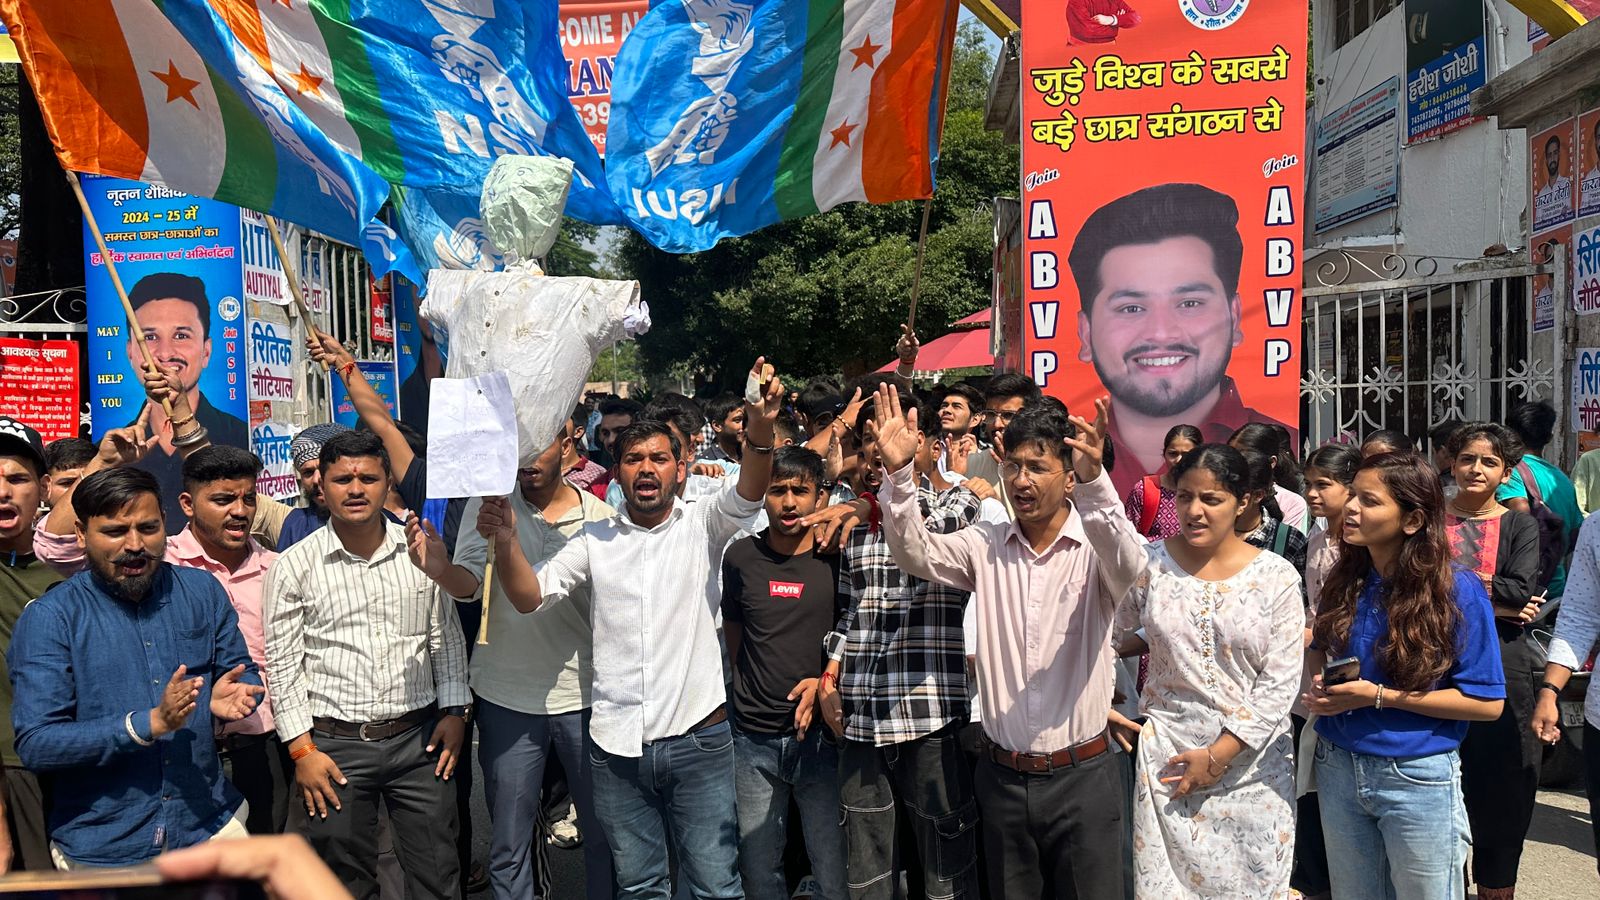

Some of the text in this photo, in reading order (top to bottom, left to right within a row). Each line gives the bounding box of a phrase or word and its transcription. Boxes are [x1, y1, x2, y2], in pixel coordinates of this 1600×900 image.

[559, 14, 615, 47] COME
[1094, 54, 1165, 91] विश्व
[1172, 50, 1205, 86] के
[1211, 45, 1290, 84] सबसे
[1408, 42, 1479, 102] हरीश जोशी
[1084, 114, 1141, 142] छात्र
[1147, 103, 1247, 138] संगठन
[1253, 96, 1284, 133] से
[1263, 153, 1298, 178] Join
[1025, 167, 1060, 191] Join
[106, 187, 142, 207] नूतन
[122, 211, 149, 224] 2024
[167, 210, 180, 222] 25
[184, 205, 199, 221] में
[104, 231, 136, 243] समस्त
[203, 227, 218, 237] का
[128, 252, 163, 263] स्वागत
[167, 249, 181, 260] एवं
[185, 245, 234, 260] अभिनंदन
[246, 271, 283, 300] AUTIYAL
[97, 326, 120, 337] MAY
[252, 321, 292, 366] रितिक
[42, 348, 67, 362] सूचना
[107, 350, 112, 360] I
[97, 374, 124, 385] HELP
[252, 367, 293, 398] नौटियाल
[101, 398, 122, 408] YOU
